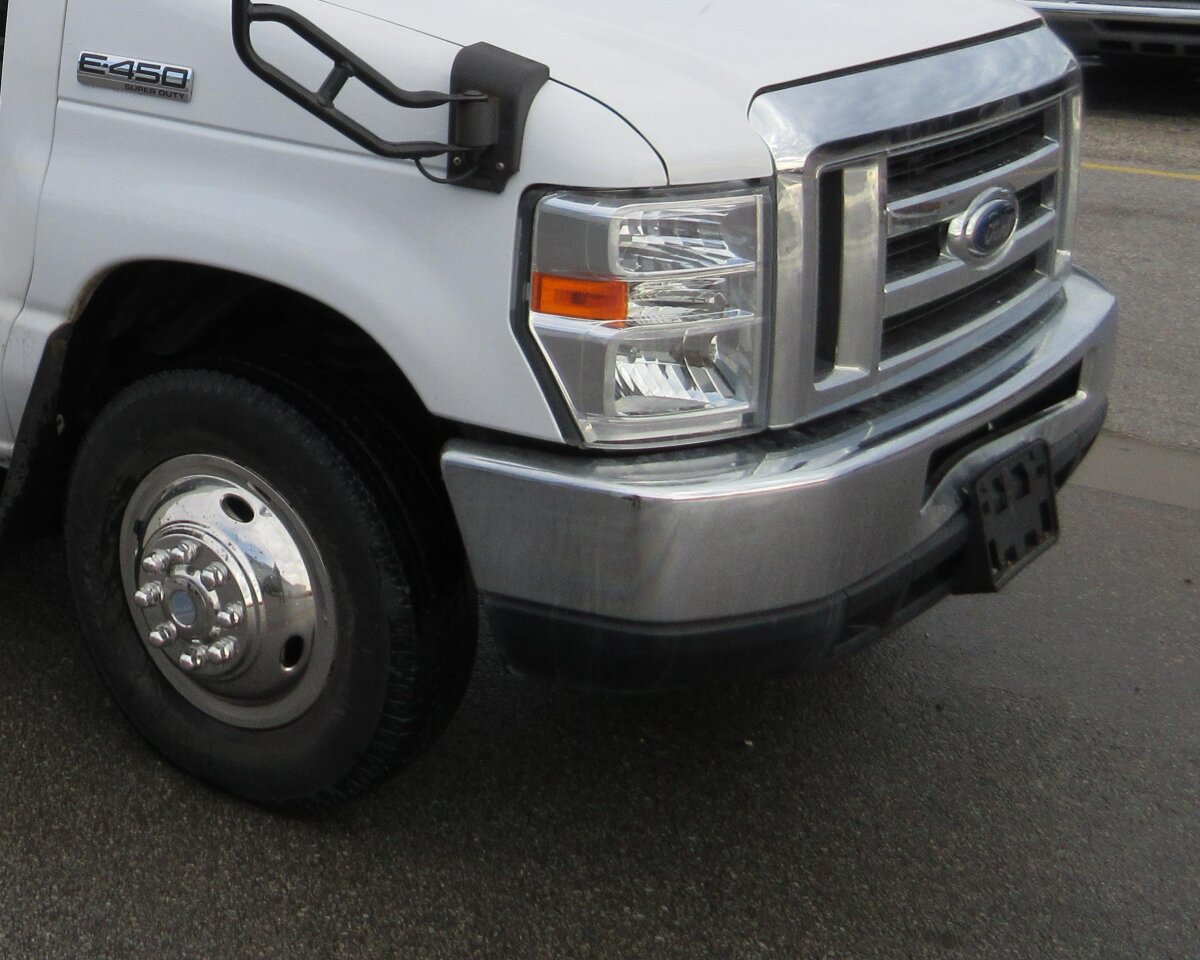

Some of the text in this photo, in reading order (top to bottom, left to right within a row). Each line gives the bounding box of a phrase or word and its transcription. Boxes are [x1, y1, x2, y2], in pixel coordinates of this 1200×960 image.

[78, 52, 189, 89] E-450
[124, 83, 185, 100] SUPER DUTY
